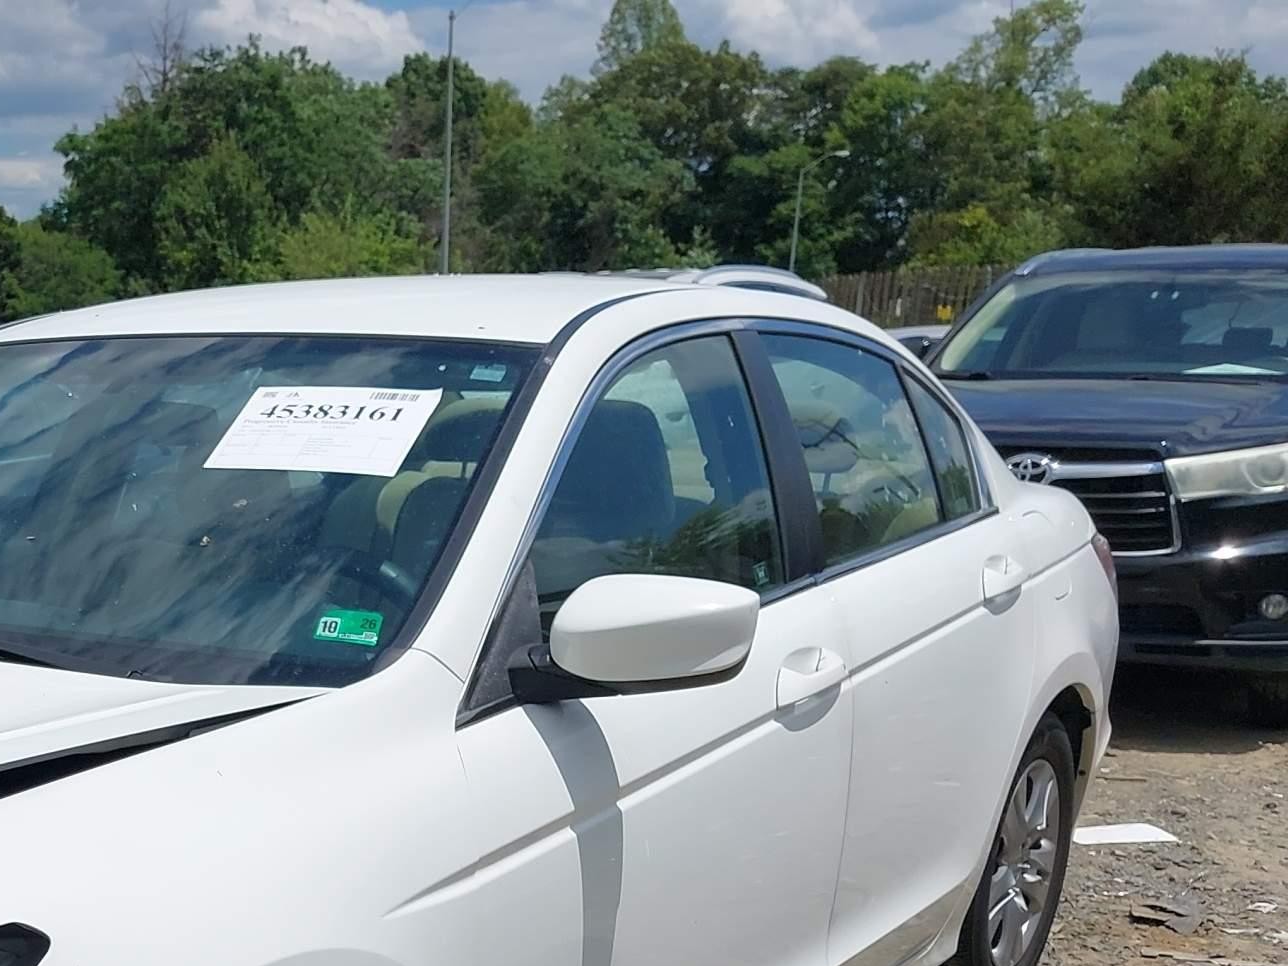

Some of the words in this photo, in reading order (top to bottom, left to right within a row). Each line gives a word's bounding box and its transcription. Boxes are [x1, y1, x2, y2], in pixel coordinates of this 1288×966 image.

[260, 404, 405, 422] 45383161
[321, 620, 338, 634] 10
[360, 618, 377, 630] 26
